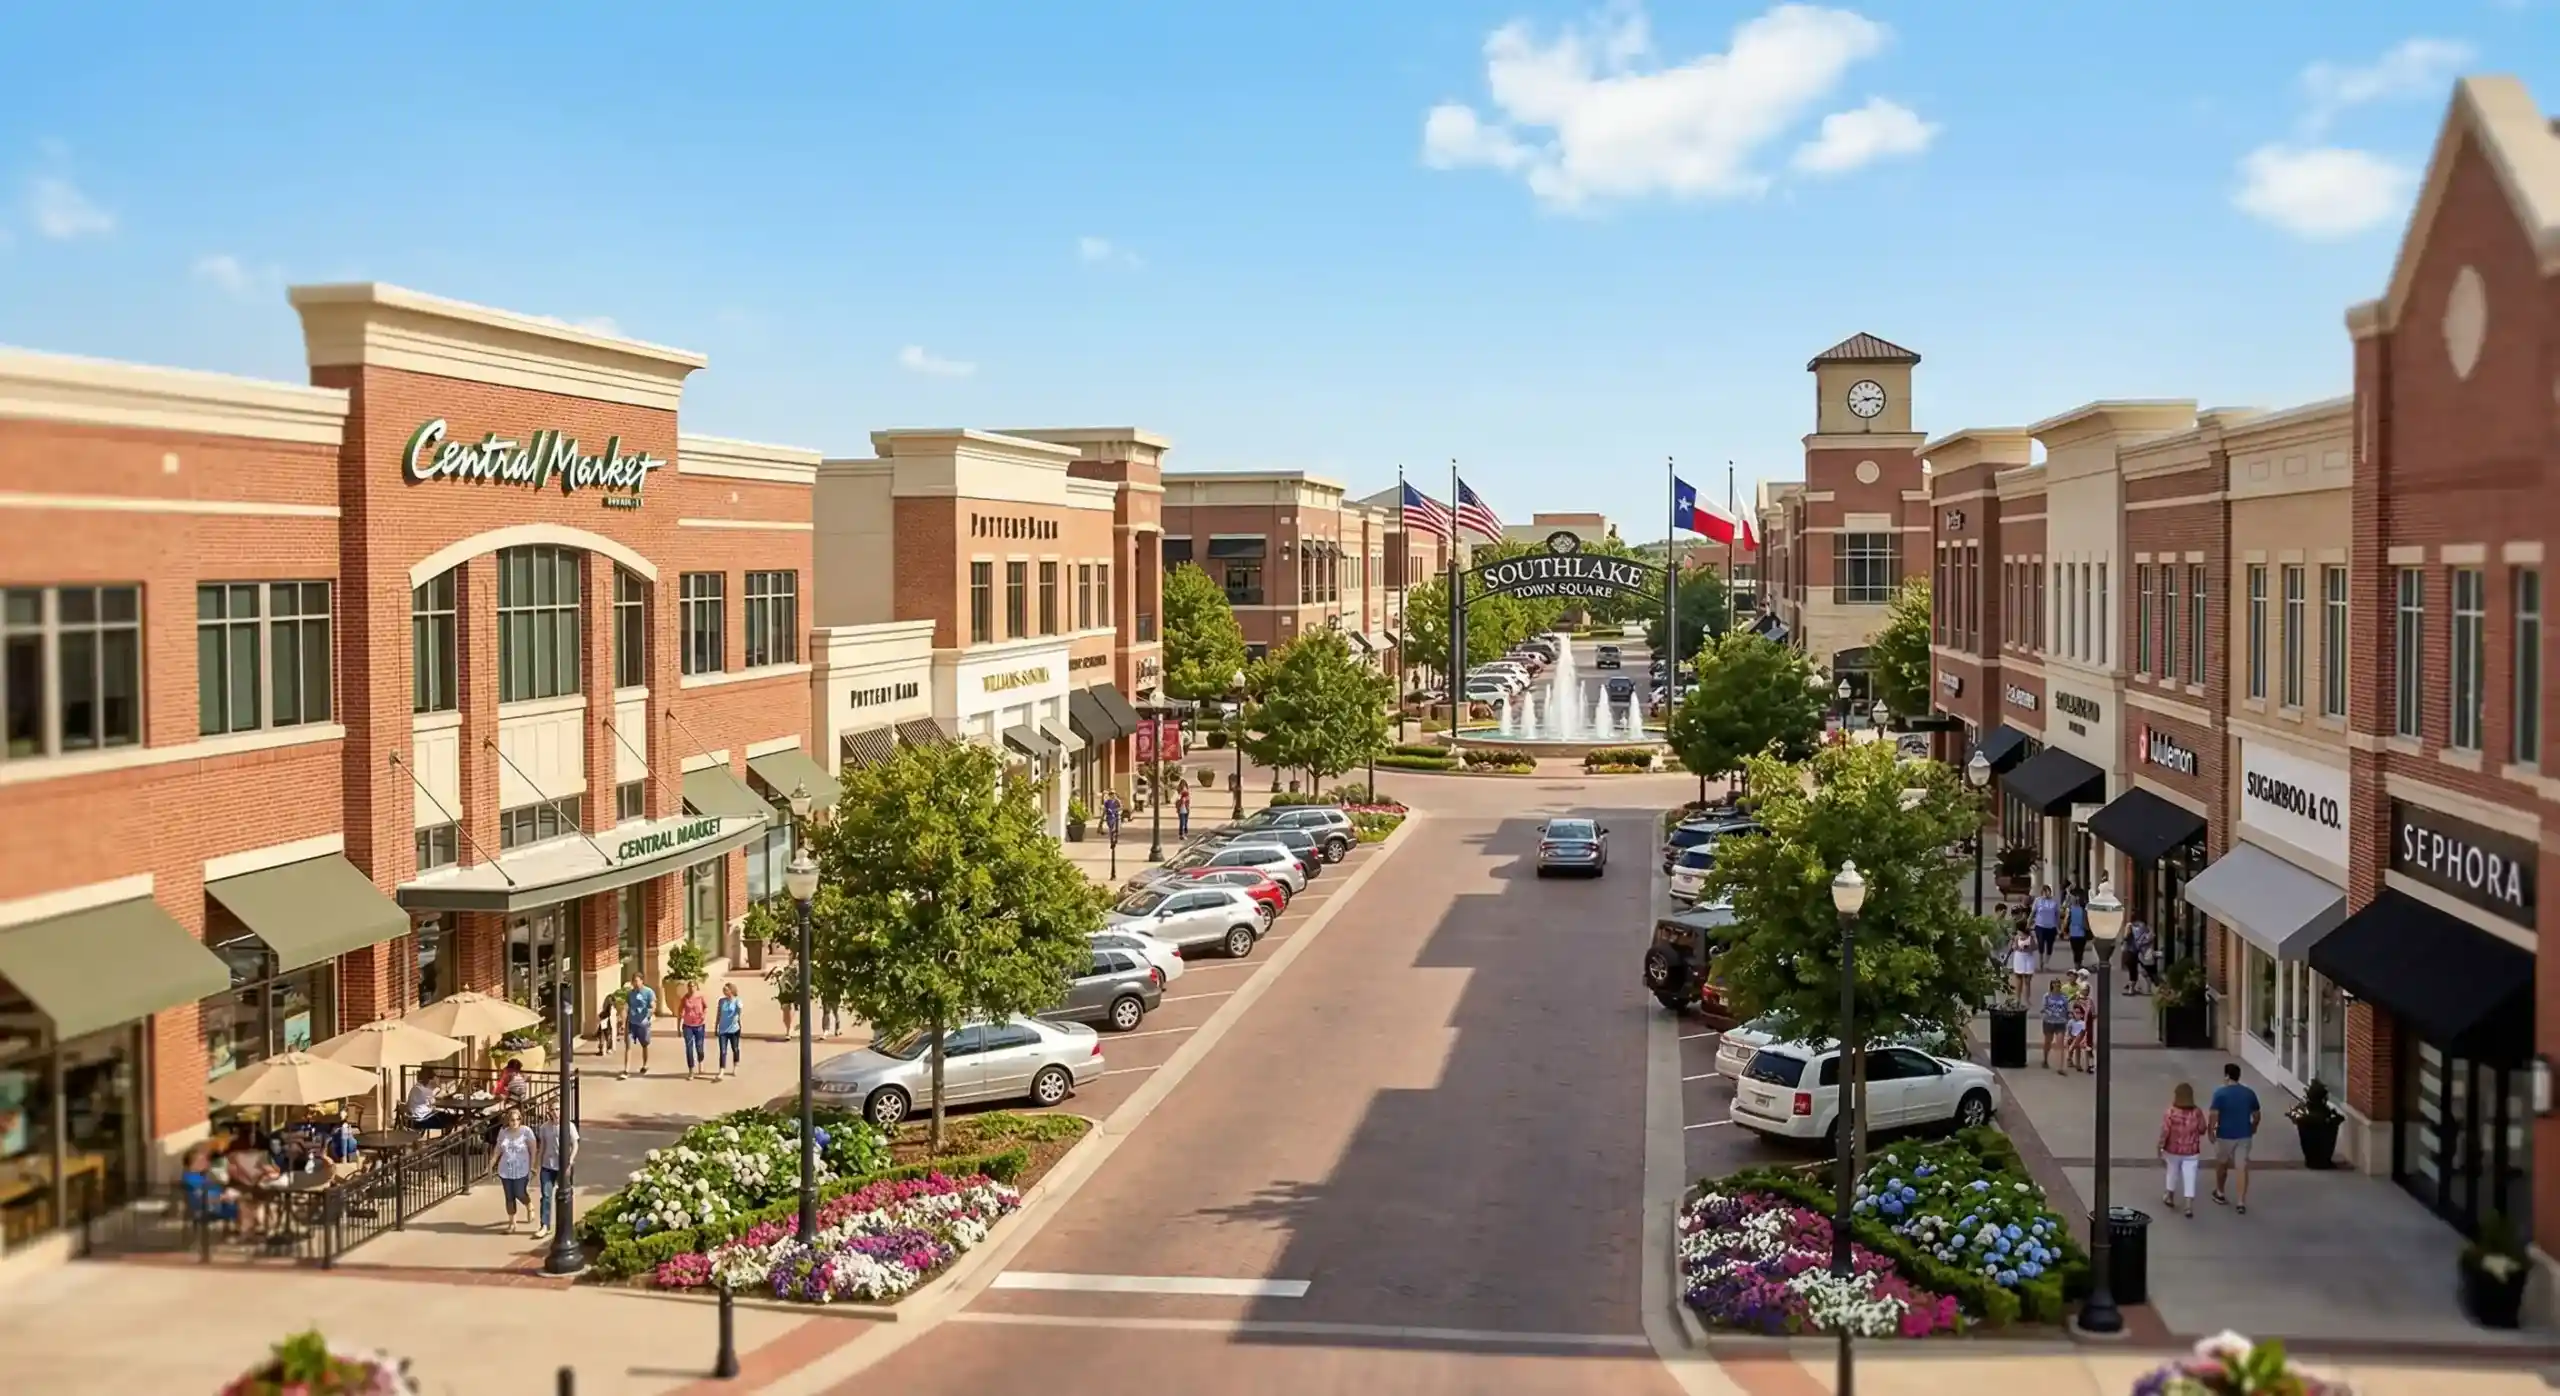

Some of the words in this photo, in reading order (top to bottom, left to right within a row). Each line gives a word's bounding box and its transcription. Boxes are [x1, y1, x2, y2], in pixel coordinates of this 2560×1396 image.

[409, 418, 546, 483] Central
[542, 430, 667, 491] Market
[1484, 557, 1643, 589] SOUTHLAKE
[1514, 583, 1556, 599] TOWN
[1558, 583, 1613, 599] SQUARE
[2246, 771, 2306, 816] SUGARBOO
[2307, 792, 2317, 821] &
[2319, 796, 2341, 830] CO.
[618, 831, 675, 860] CENTRAL
[676, 817, 722, 846] MARKET
[2402, 823, 2523, 908] SEPHORA
